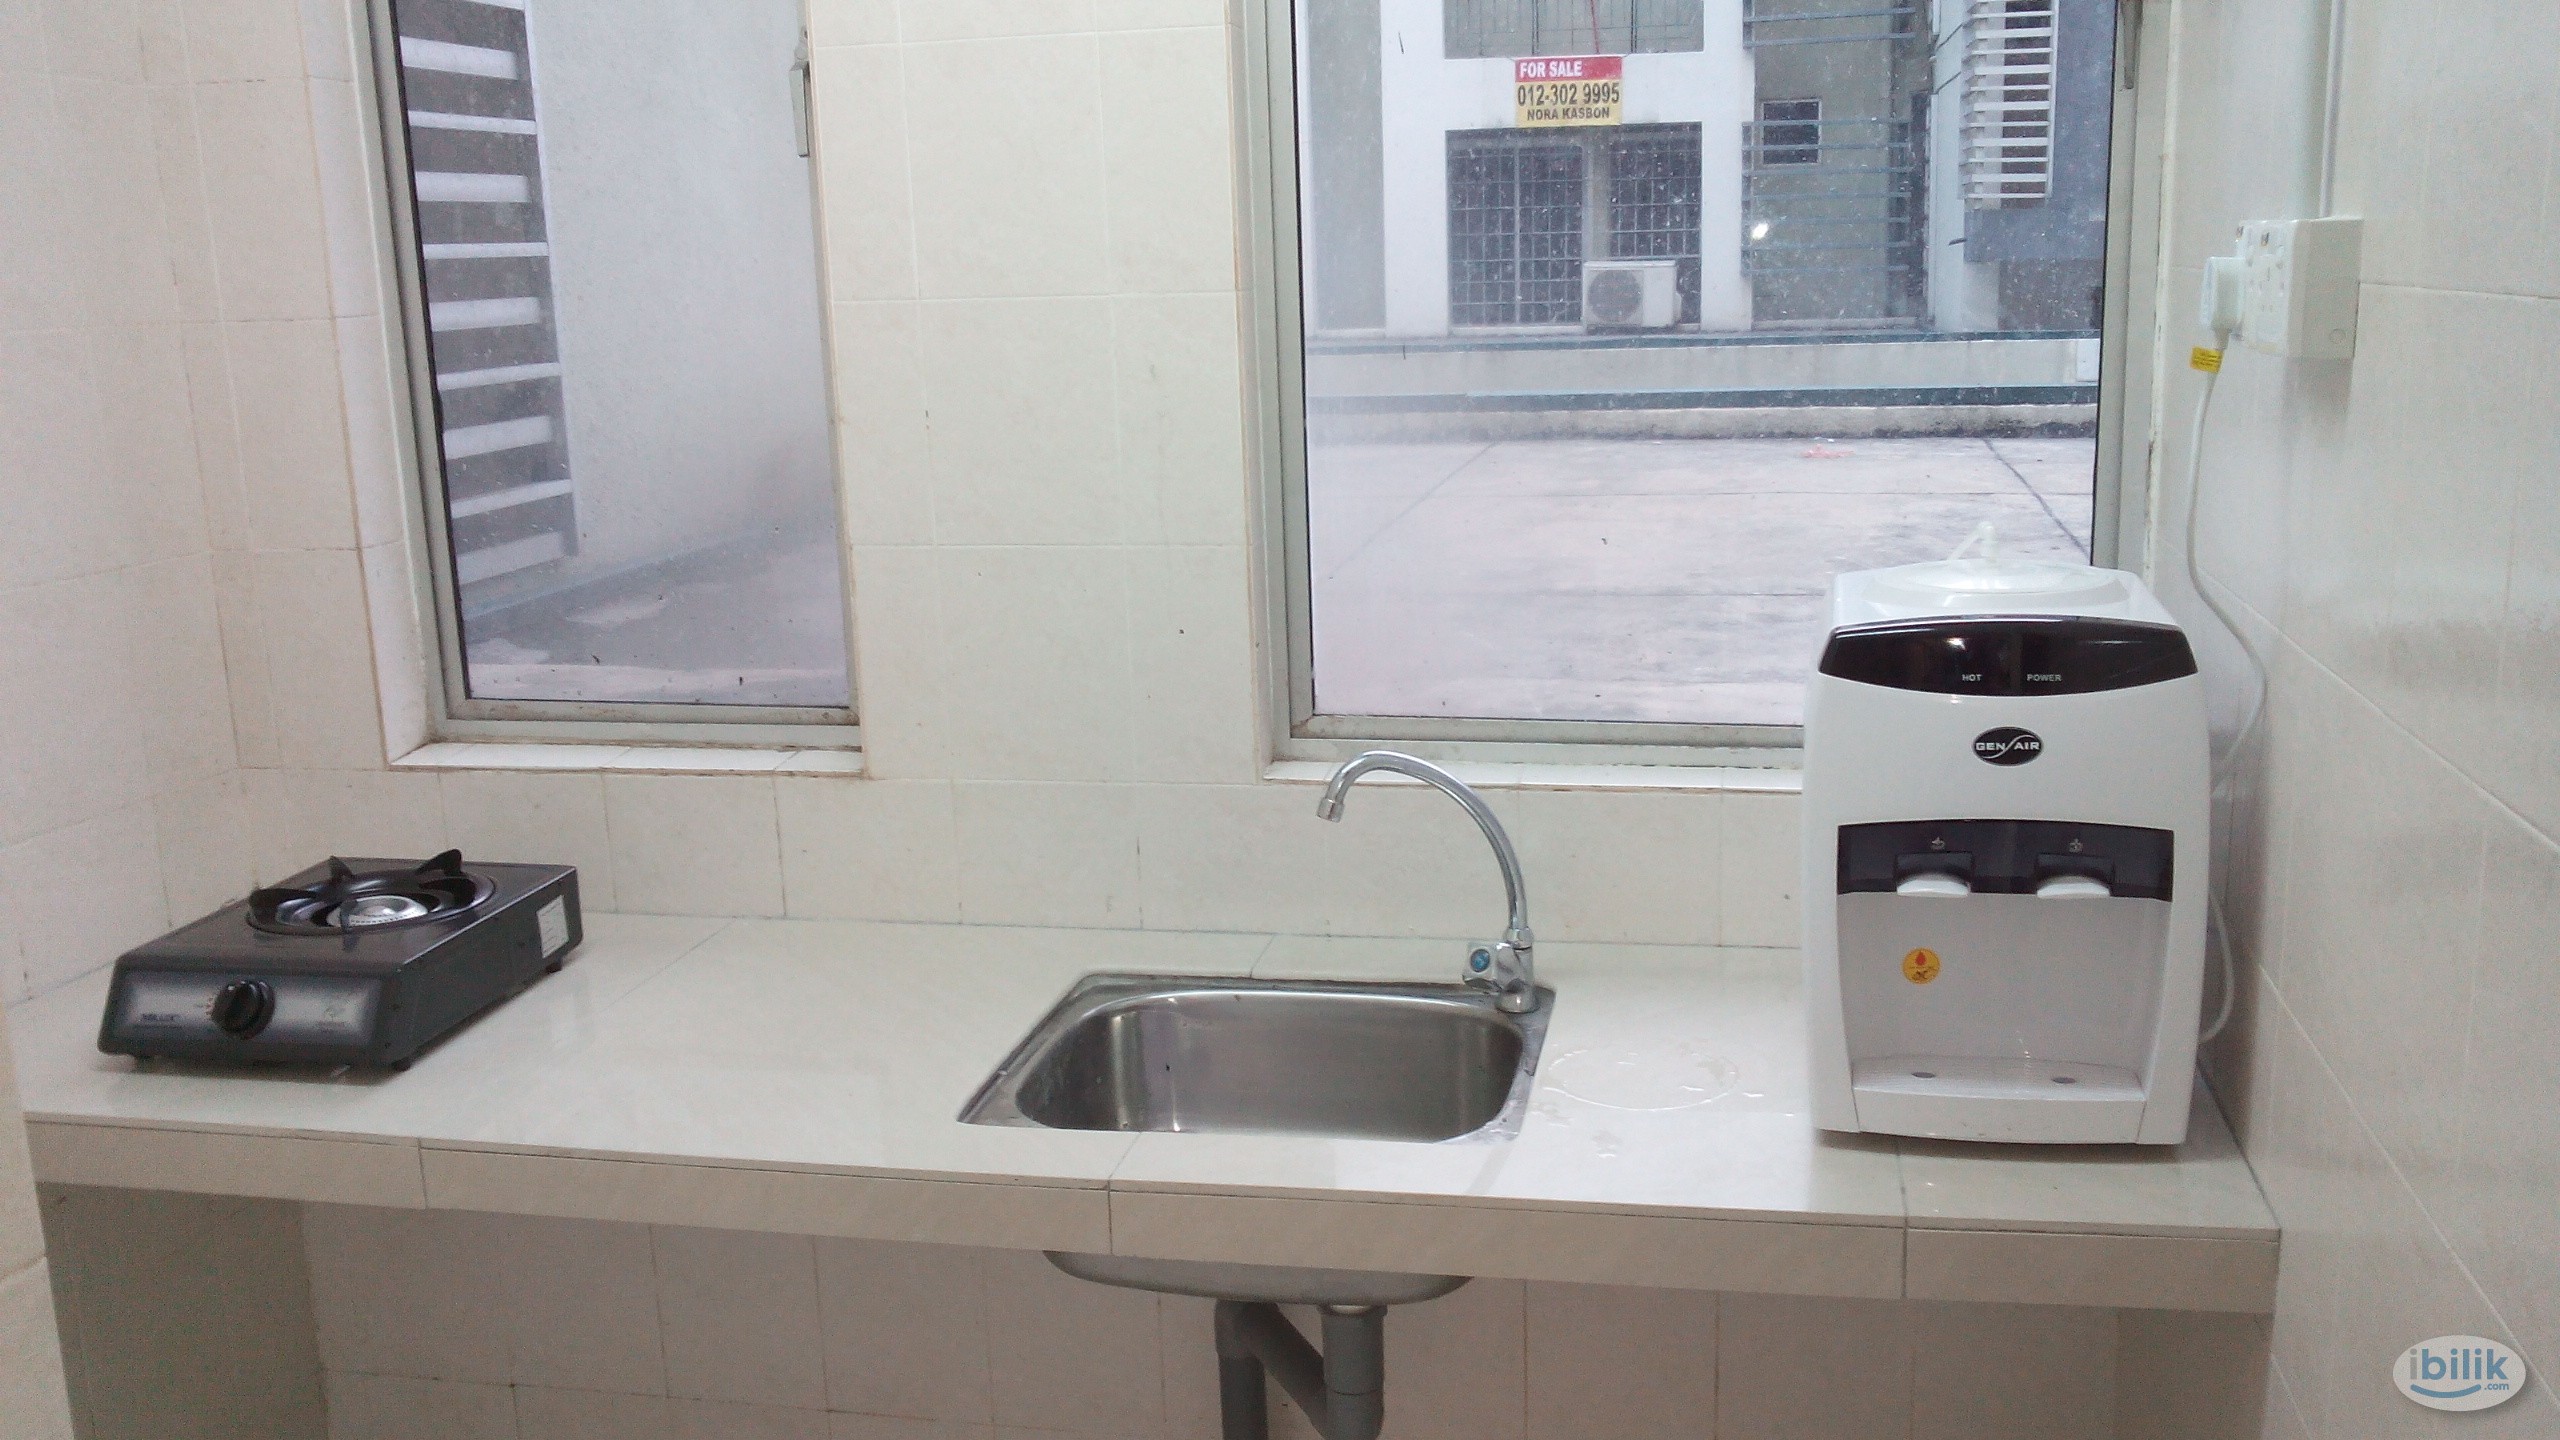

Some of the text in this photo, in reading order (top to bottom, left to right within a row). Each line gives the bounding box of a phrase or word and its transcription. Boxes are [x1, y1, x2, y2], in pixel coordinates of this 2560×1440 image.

[1520, 60, 1583, 79] FOR SALE
[1517, 82, 1620, 106] 012-302 9995
[1527, 107, 1610, 121] NORA KASBON
[1961, 673, 1982, 682] HOT
[2026, 673, 2062, 682] POWER
